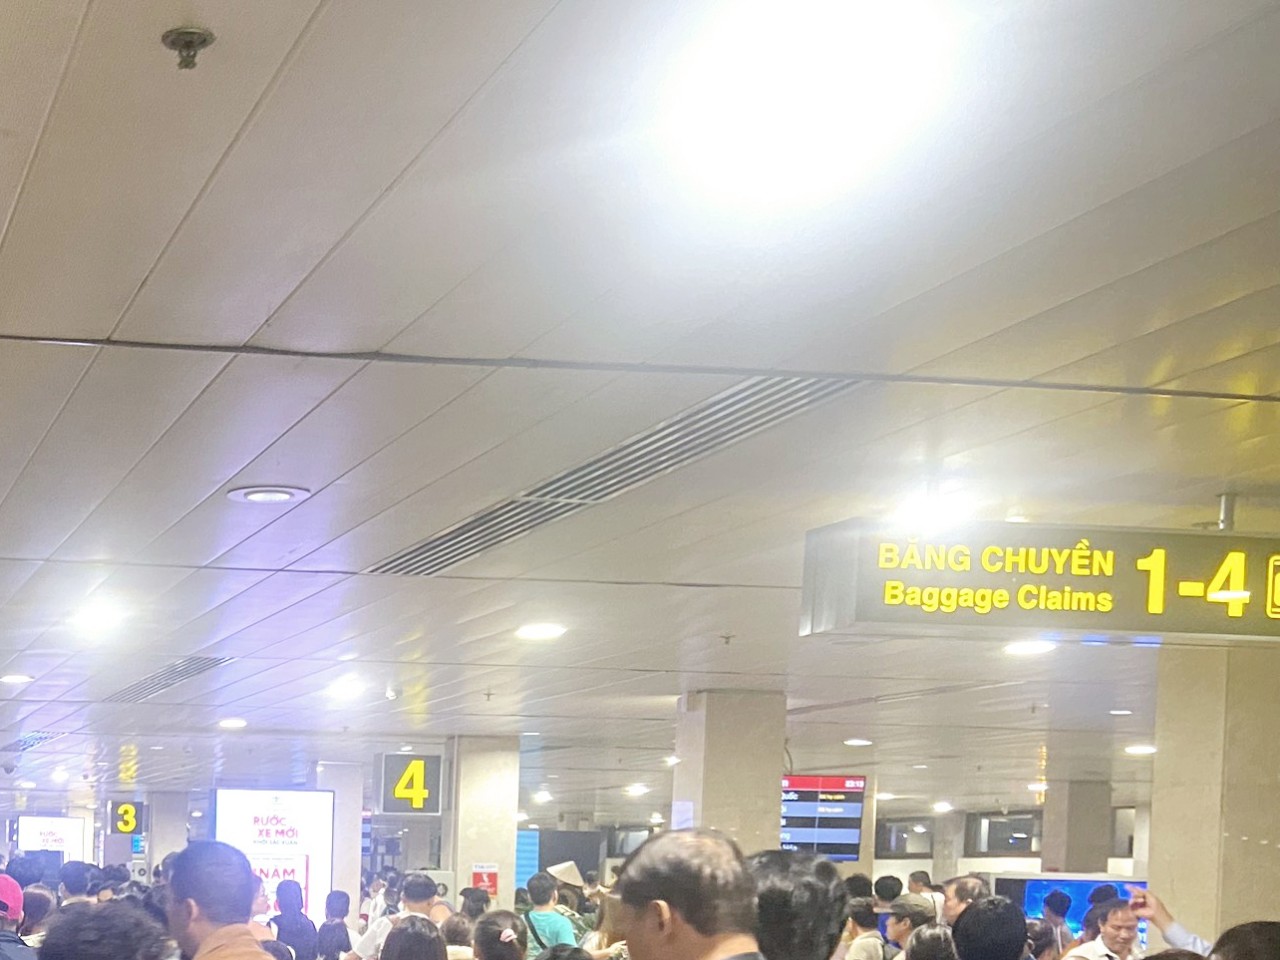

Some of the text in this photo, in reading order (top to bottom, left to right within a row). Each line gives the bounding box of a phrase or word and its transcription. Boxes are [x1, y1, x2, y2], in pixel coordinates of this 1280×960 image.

[878, 537, 1114, 576] BĂNG CHUYỀN
[884, 580, 1114, 614] Baggage Claims
[1136, 548, 1250, 617] 1-4
[394, 759, 429, 809] 4
[116, 803, 137, 833] 3
[258, 829, 271, 838] XE
